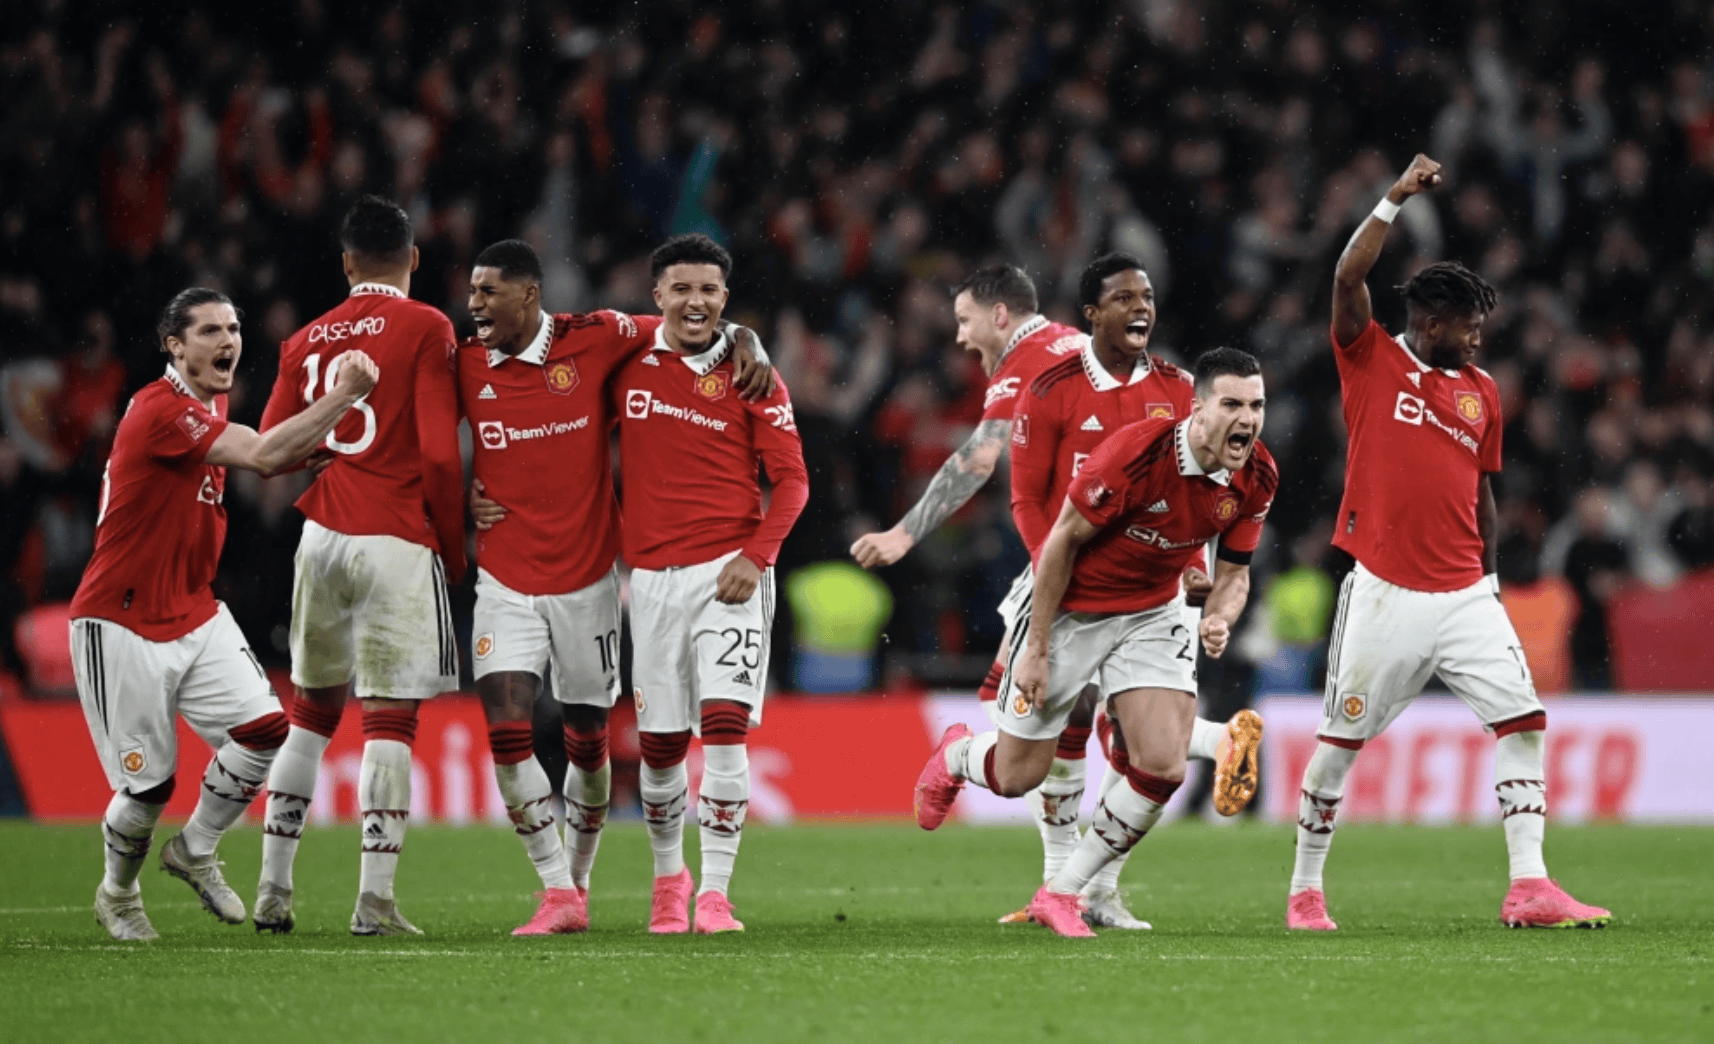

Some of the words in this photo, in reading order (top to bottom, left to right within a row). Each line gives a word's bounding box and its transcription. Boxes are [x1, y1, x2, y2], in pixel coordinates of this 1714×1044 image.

[505, 415, 589, 441] TeamViewer
[652, 400, 728, 432] TeamViewer
[594, 629, 617, 674] 10
[715, 627, 761, 670] 25
